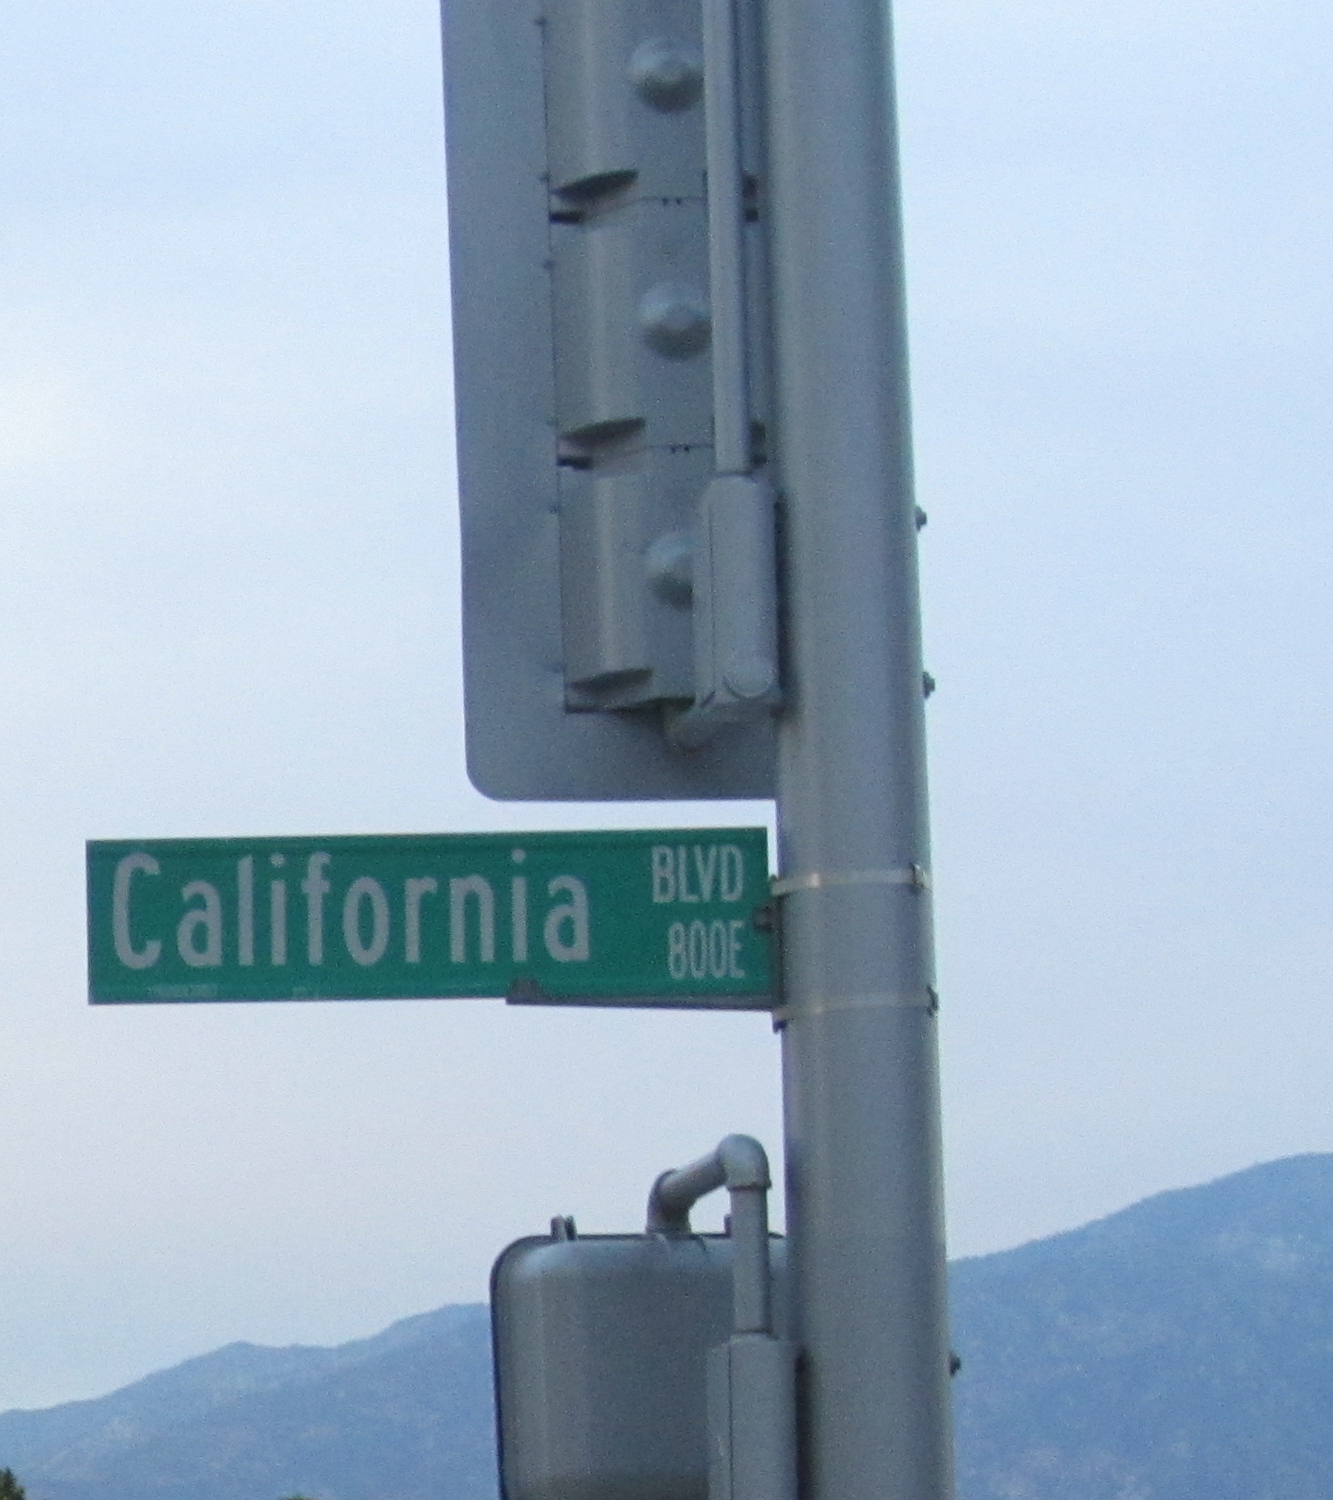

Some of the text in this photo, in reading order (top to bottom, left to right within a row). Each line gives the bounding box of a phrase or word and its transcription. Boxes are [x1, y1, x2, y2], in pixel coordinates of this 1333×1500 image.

[111, 844, 745, 970] California BLVD
[666, 919, 746, 980] 800E
